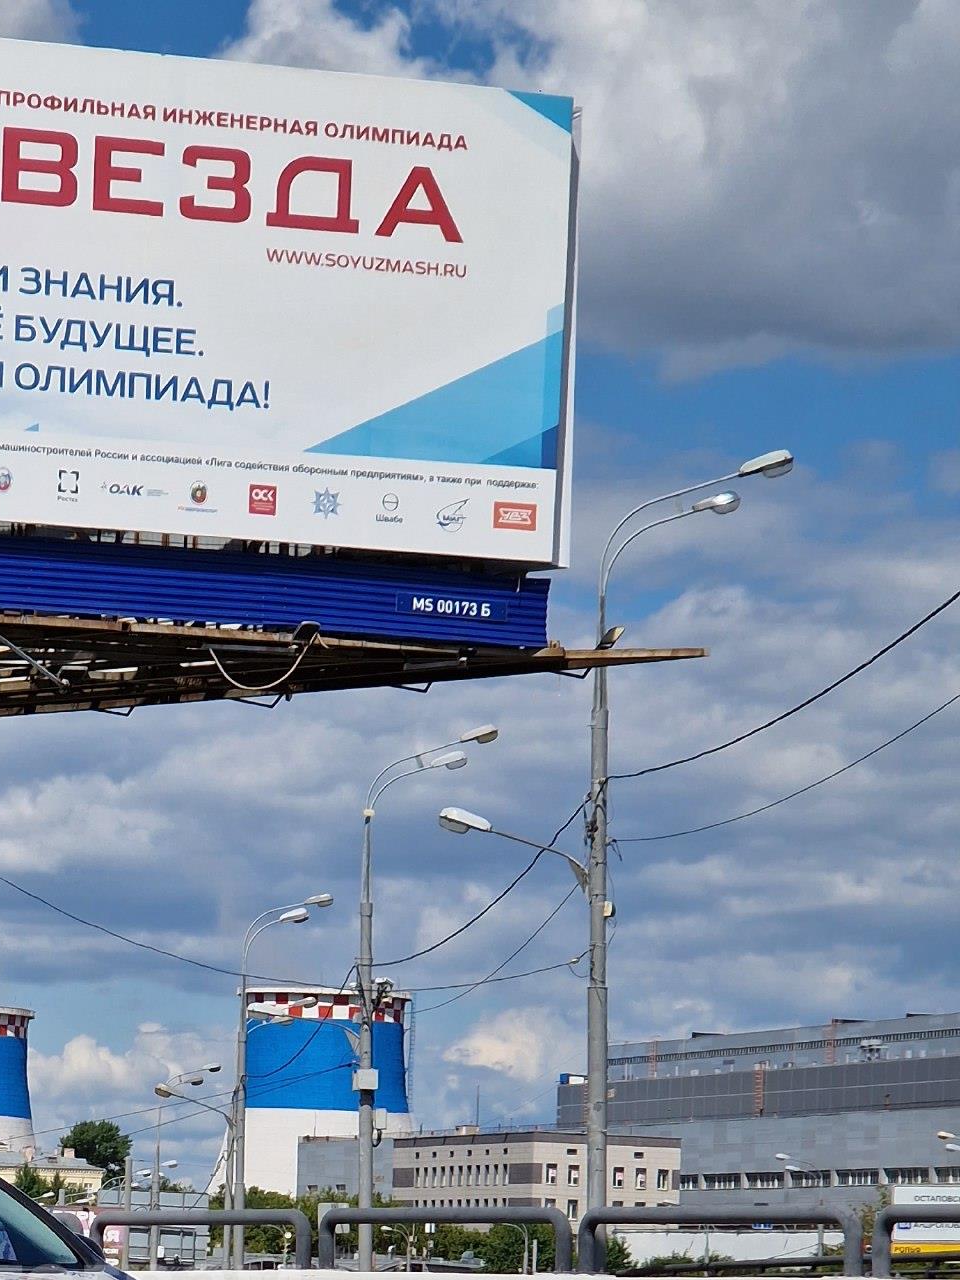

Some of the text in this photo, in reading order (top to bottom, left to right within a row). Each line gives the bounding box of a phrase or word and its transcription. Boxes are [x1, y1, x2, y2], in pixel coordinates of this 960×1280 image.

[162, 106, 319, 137] ИНЖЕНЕРНАЯ
[324, 122, 469, 152] ОЛИМПИАДА
[265, 247, 468, 279] WWW.SOYUZMASH.RU
[18, 267, 184, 308] ЗНАНИЯ.
[14, 314, 204, 357] БУДУЩЕЕ.
[14, 362, 270, 411] ОЛИМПИАДА!
[94, 449, 129, 461] России
[131, 453, 138, 461] и
[140, 453, 203, 467] ассоциацией
[205, 457, 233, 469] «Лига
[234, 461, 290, 473] содействия
[292, 464, 349, 477] оборонным
[428, 475, 435, 483] а
[436, 475, 463, 485] также
[464, 478, 482, 487] при
[109, 483, 144, 498] ОАК
[375, 513, 404, 524] Швабе
[436, 600, 478, 616] 00173
